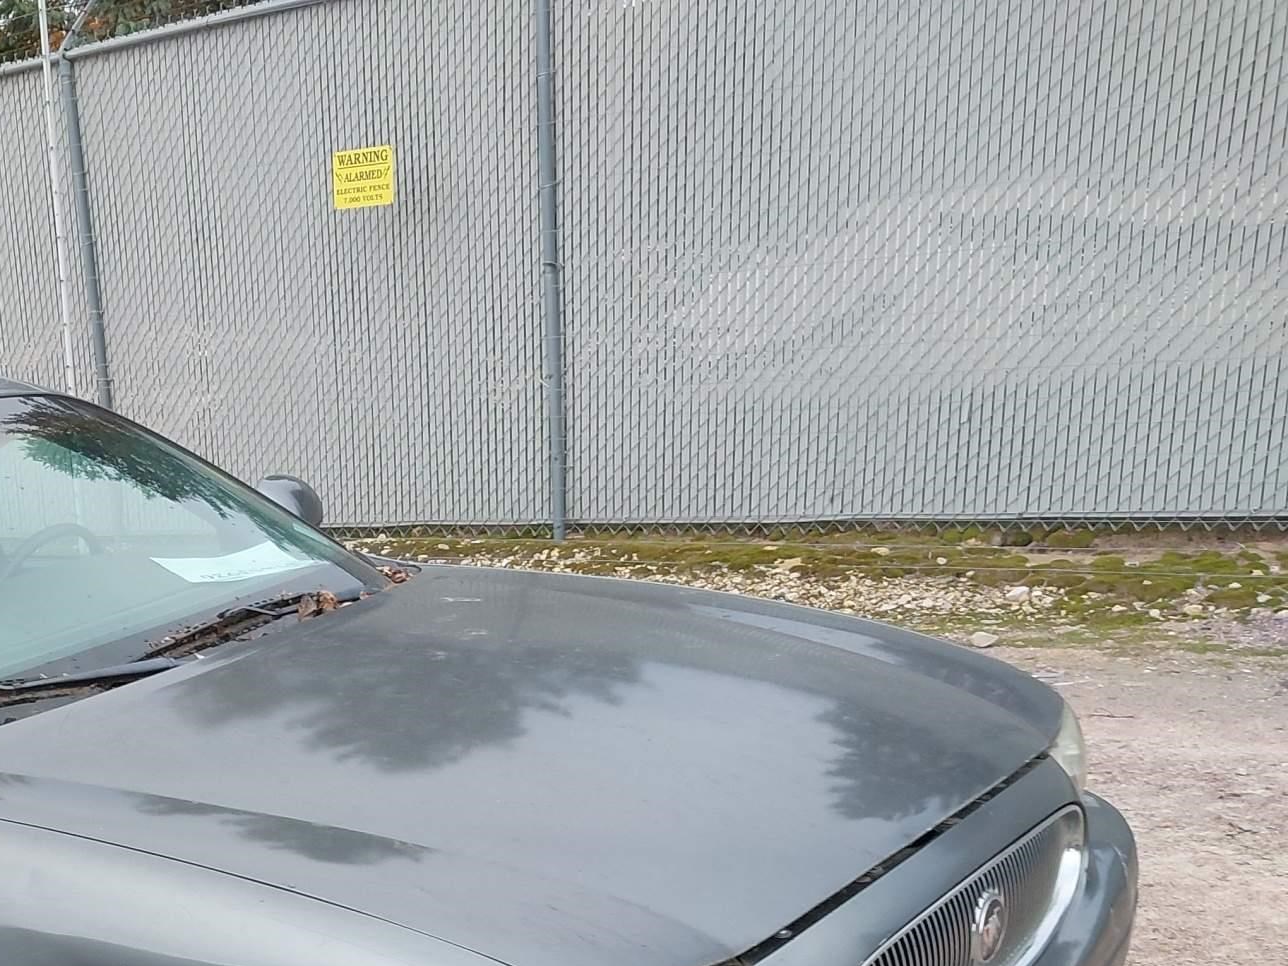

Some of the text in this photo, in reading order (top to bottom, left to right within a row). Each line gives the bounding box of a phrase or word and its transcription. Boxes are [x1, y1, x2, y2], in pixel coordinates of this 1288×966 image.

[337, 149, 388, 166] WARNING
[344, 169, 383, 182] ALARMED
[336, 184, 390, 195] ELECTRIC FENCE
[362, 194, 383, 202] VOLTS
